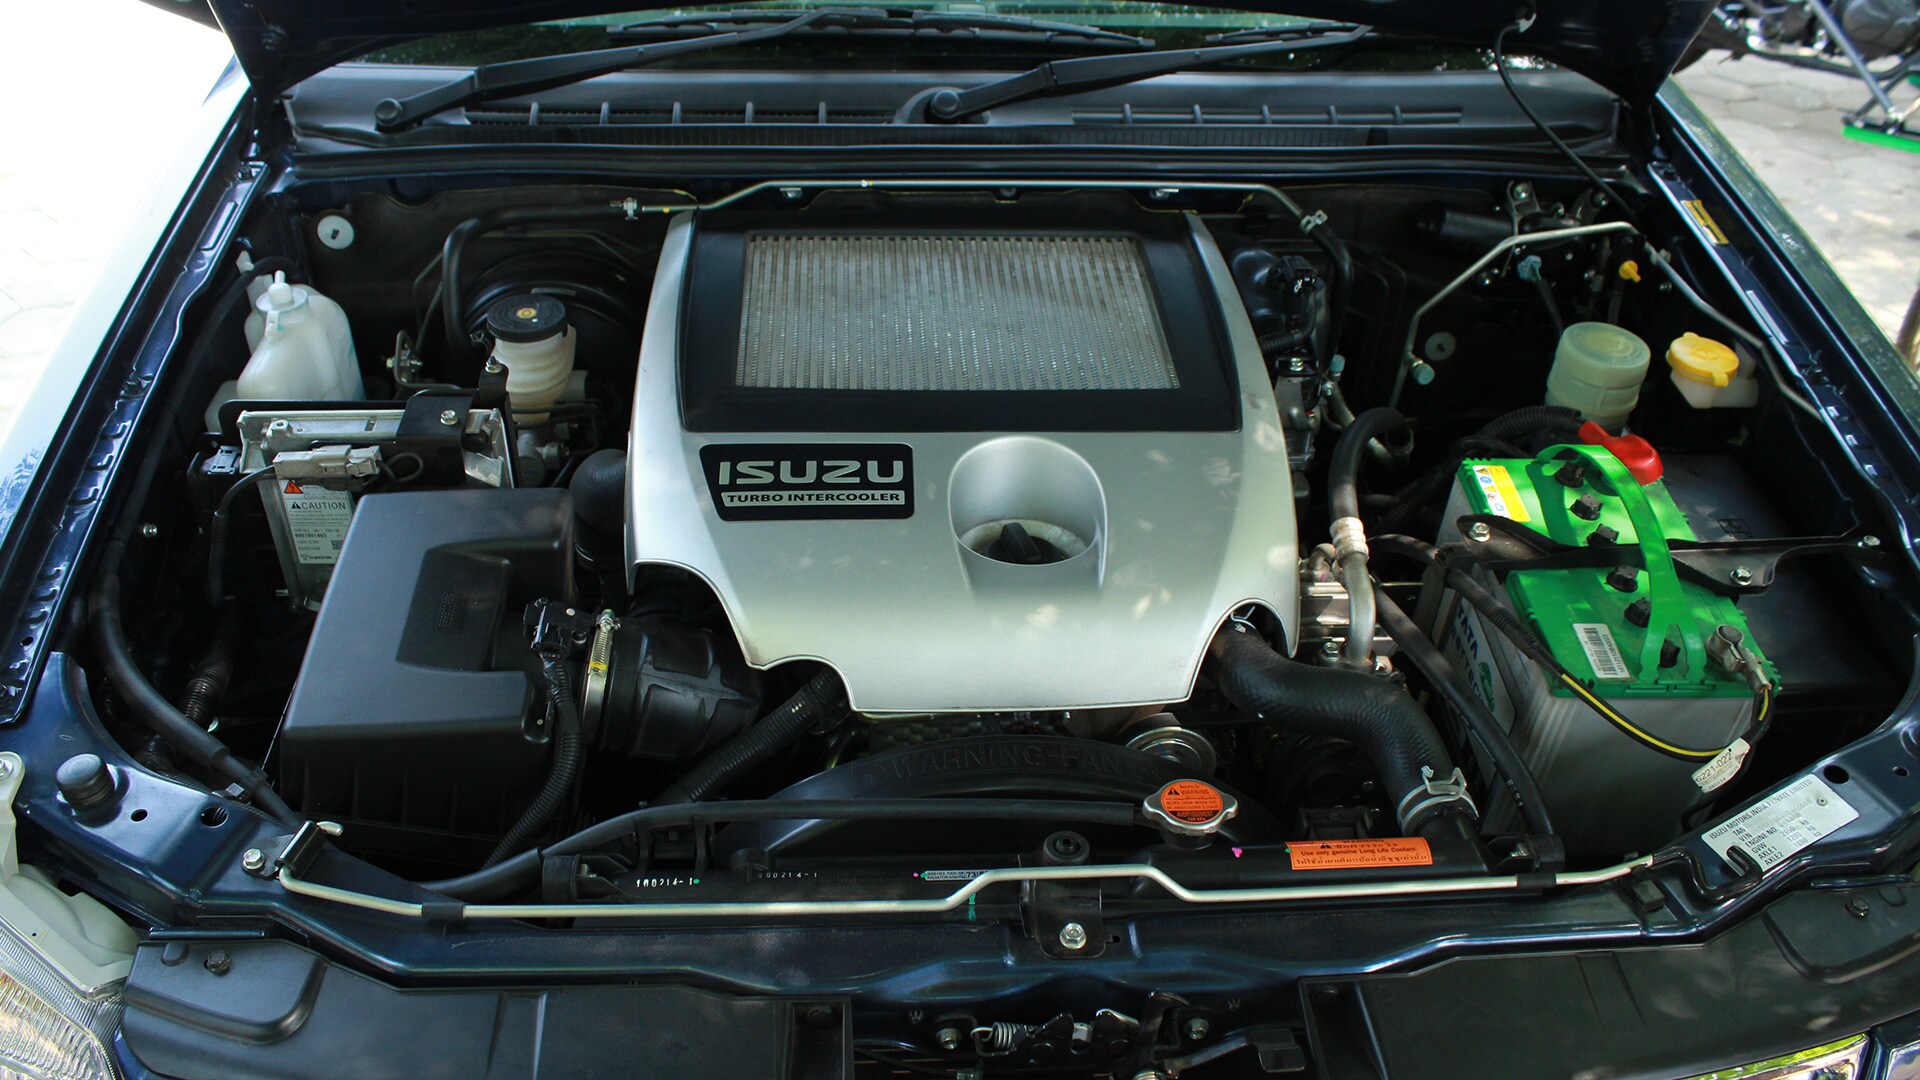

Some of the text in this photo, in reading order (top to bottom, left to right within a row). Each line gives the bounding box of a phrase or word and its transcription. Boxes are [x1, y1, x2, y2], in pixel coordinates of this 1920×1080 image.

[718, 460, 904, 485] ISUZU
[727, 492, 900, 503] TURBO INTERCOOLER
[302, 502, 346, 510] CAUTION
[1709, 826, 1728, 840] ISUZU
[1727, 813, 1752, 829] MOTORS
[1751, 804, 1768, 816] INDIA
[1738, 832, 1752, 841] VIN
[1745, 827, 1777, 848] ENGINE NO
